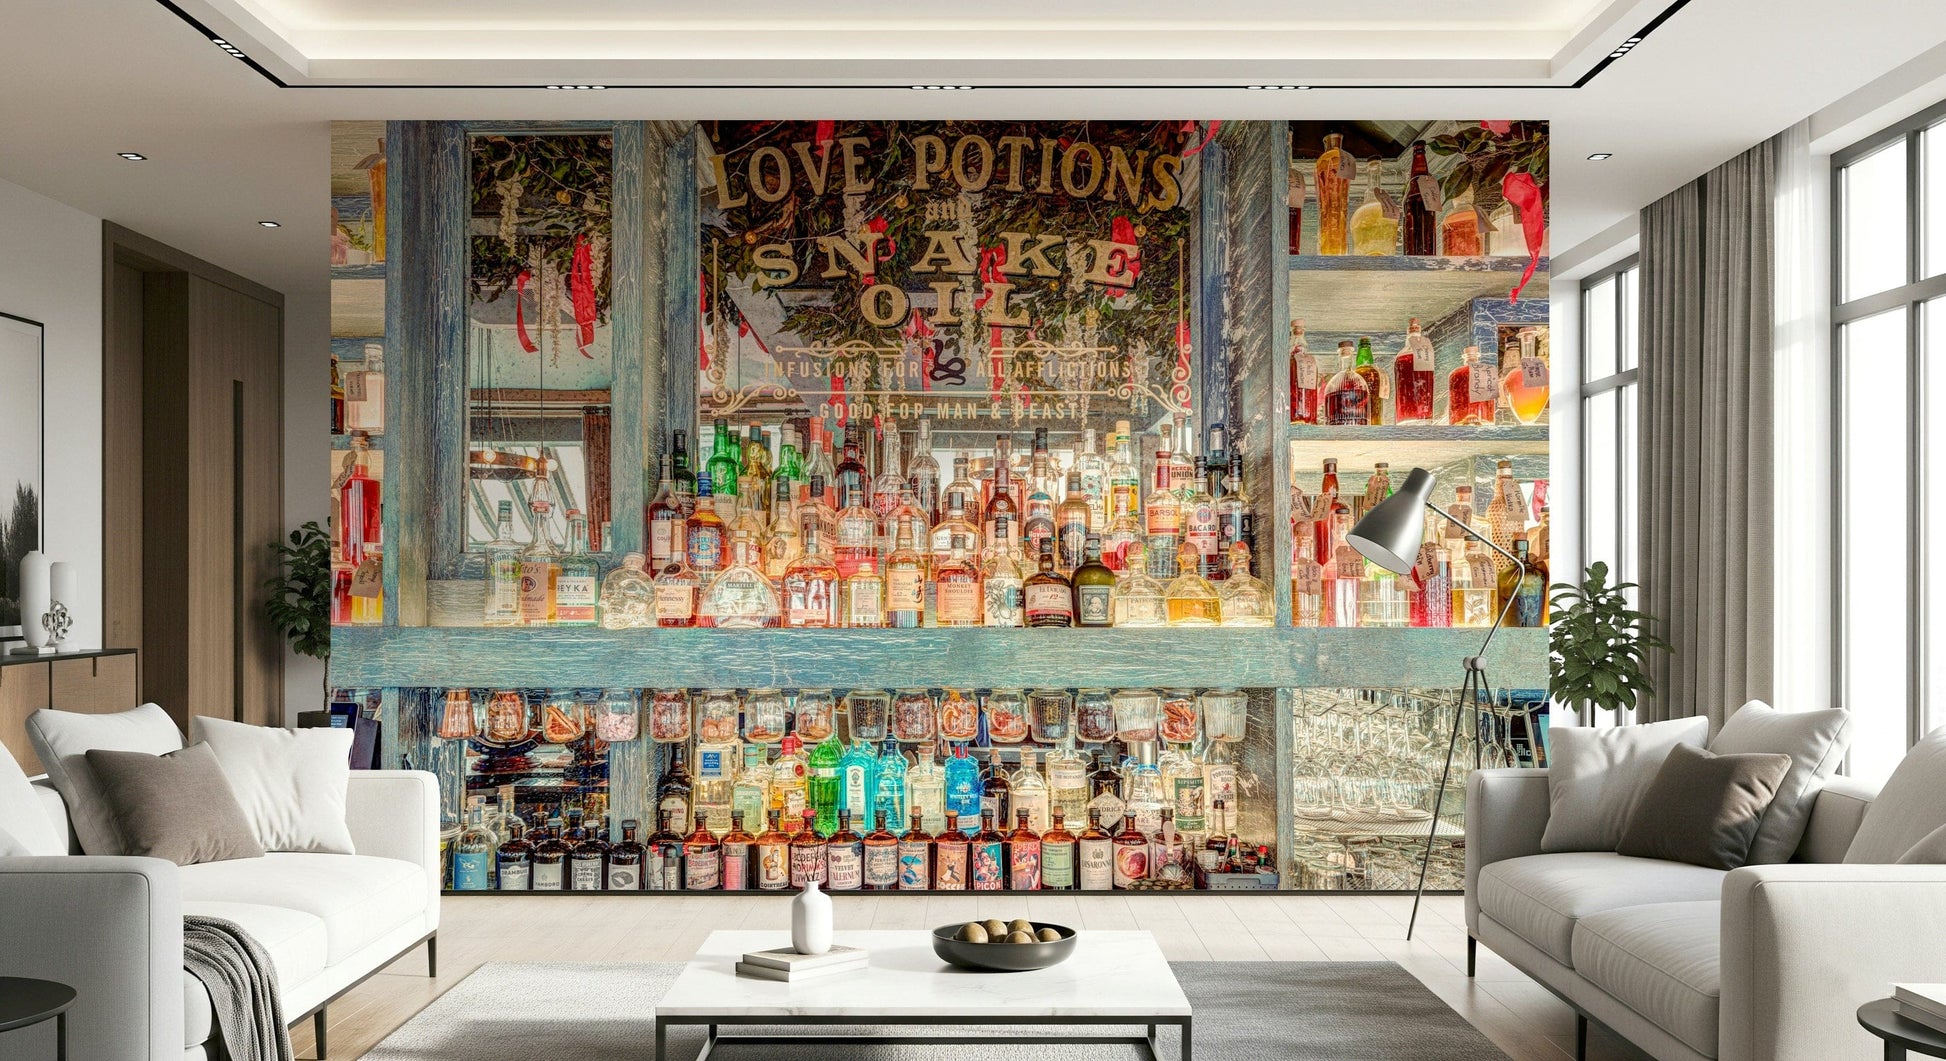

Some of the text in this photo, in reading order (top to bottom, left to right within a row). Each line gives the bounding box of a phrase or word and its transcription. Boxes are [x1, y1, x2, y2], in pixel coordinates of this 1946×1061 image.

[709, 134, 1185, 212] LOVE POTIONS
[925, 198, 972, 221] and
[753, 230, 1140, 288] SNAKE
[860, 281, 1031, 327] OIL
[764, 361, 1132, 379] INFUSIONS FOR ALL AFFLICTIONS
[1472, 364, 1485, 395] Brandy
[1486, 365, 1496, 391] Apricot
[819, 403, 874, 420] GOOD
[937, 403, 977, 420] MAN
[990, 403, 1003, 420] &
[1016, 403, 1079, 420] BEAST
[1149, 509, 1178, 517] BARSOL
[760, 880, 788, 888] COINTREAU
[976, 881, 1001, 890] PICON
